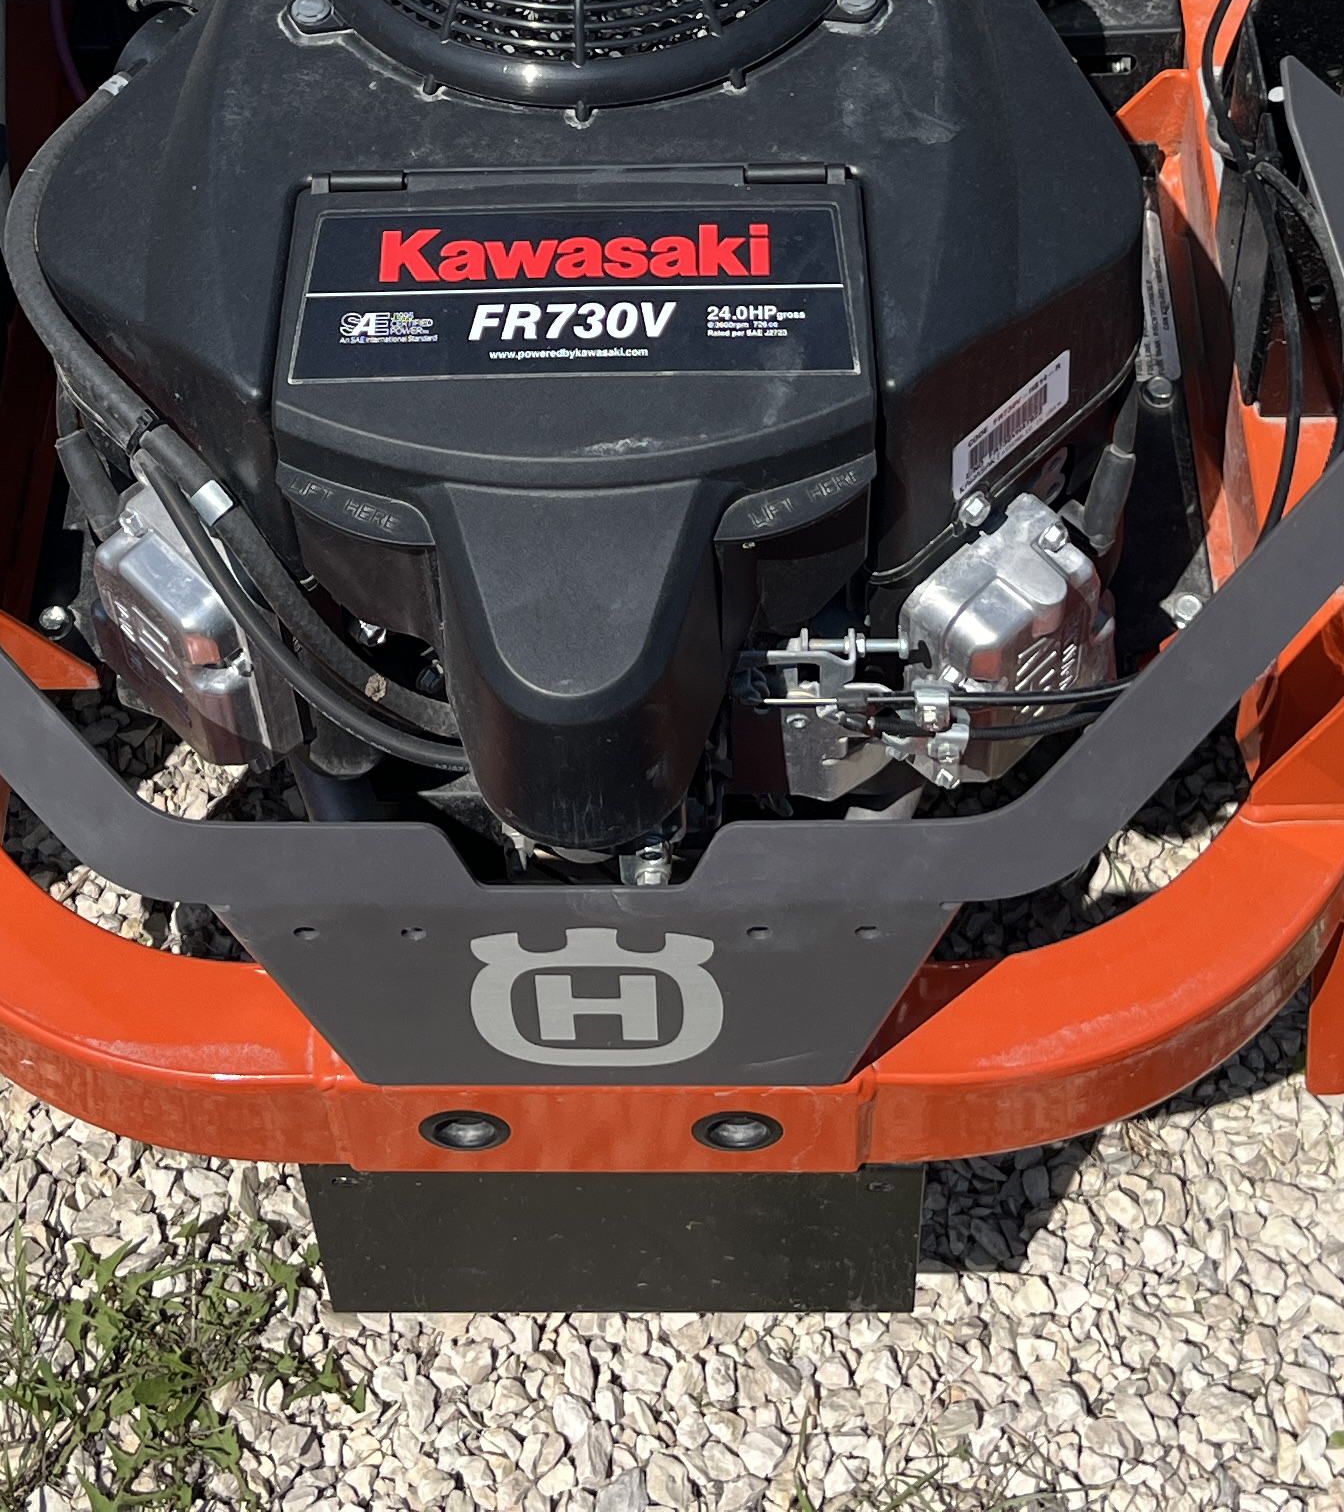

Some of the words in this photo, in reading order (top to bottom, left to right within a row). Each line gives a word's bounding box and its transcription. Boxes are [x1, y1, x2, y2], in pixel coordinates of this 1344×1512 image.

[379, 223, 770, 282] Kawasaki
[340, 312, 390, 336] SAE
[468, 301, 676, 341] FR730V
[489, 347, 648, 360] www.poweredbykawasaki.com
[290, 477, 334, 502] LIFT
[345, 498, 400, 533] HERE
[747, 497, 794, 529] LIFT
[806, 470, 864, 502] HERE
